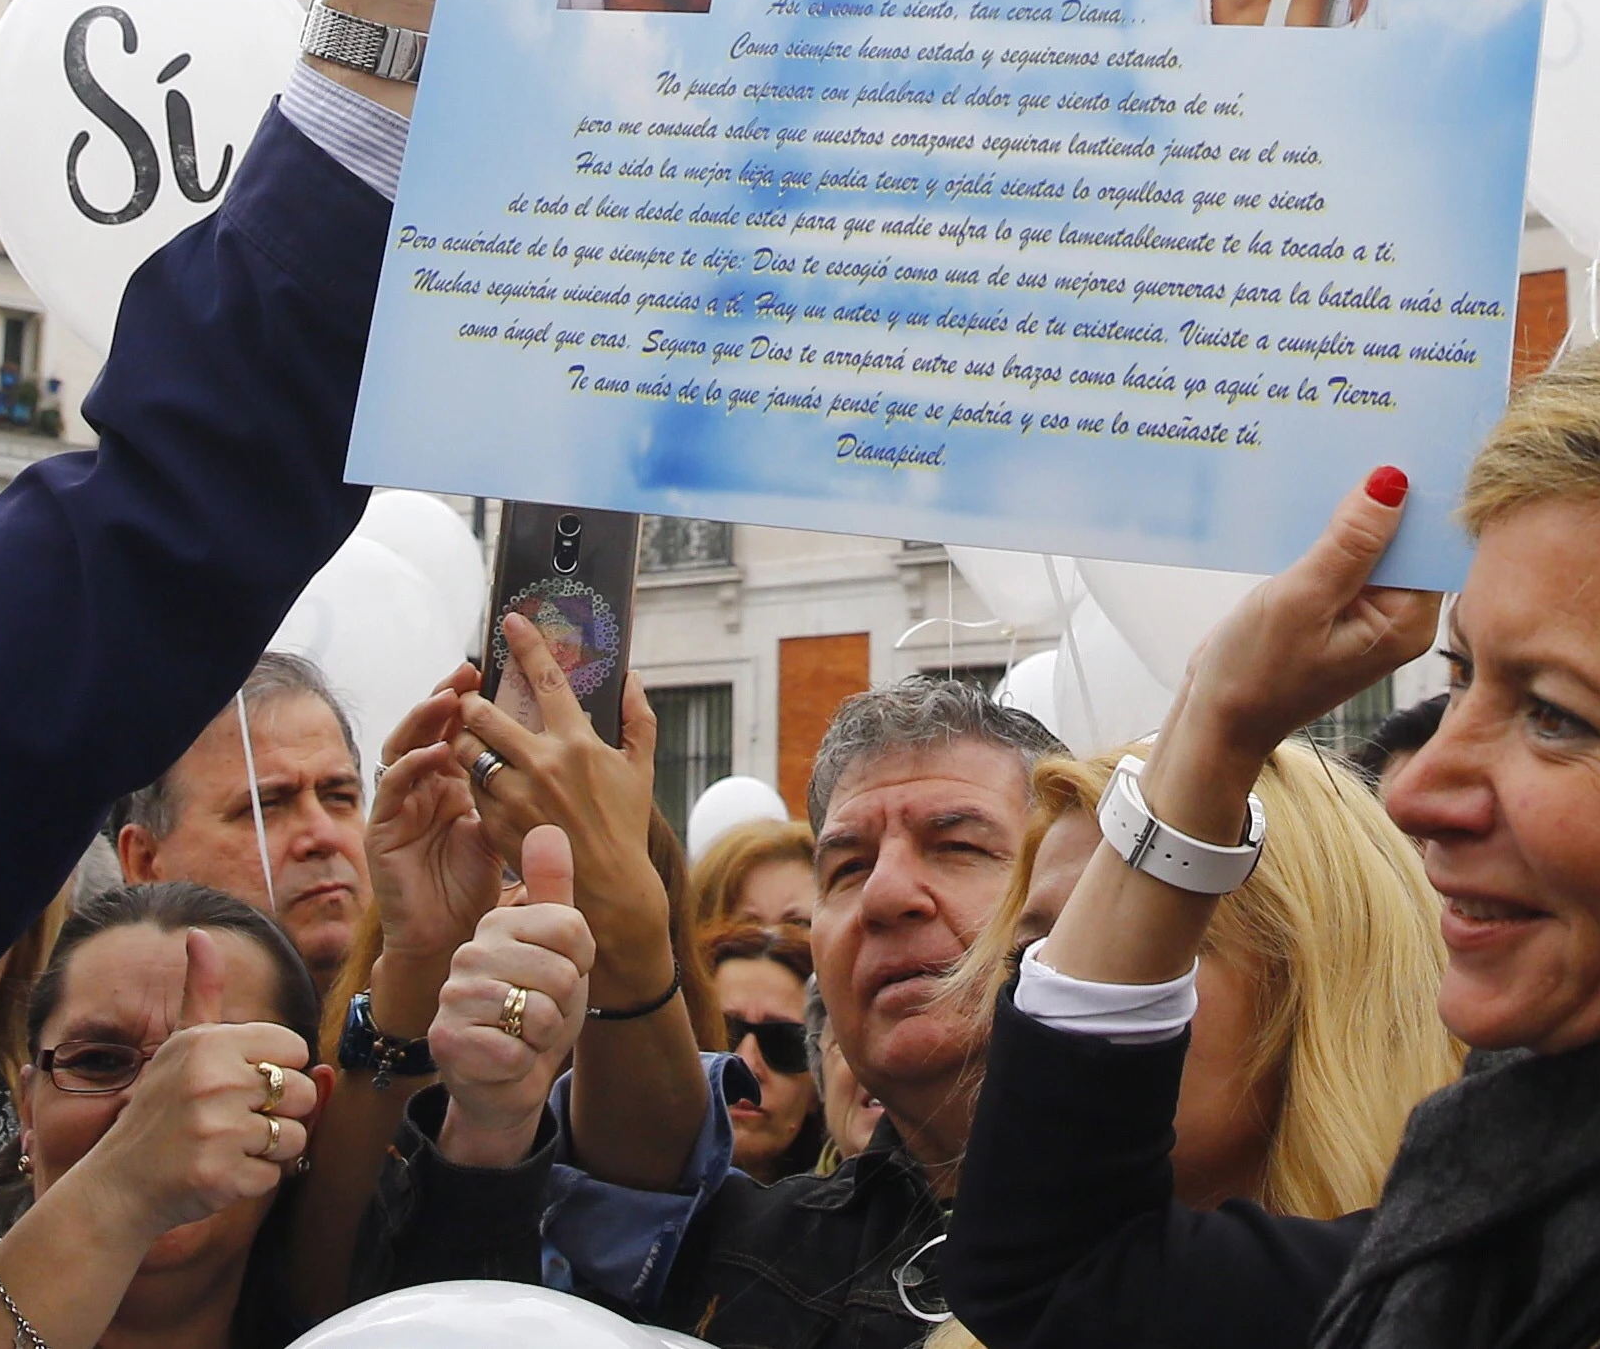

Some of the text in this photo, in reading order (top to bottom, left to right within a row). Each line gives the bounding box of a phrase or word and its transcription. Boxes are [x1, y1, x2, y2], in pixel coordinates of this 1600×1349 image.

[968, 0, 1002, 21] tan
[1005, 6, 1054, 23] cerca
[728, 30, 1184, 73] Como siempre hemos estado seguiremos estando.
[62, 4, 234, 226] Sí
[655, 69, 683, 97] No
[682, 75, 738, 102] puedo
[742, 81, 816, 104] expresar
[820, 86, 851, 102] con
[851, 78, 937, 110] palabras
[963, 84, 1012, 108] dolor
[1016, 92, 1052, 118] que
[1055, 91, 1112, 112] siento
[1115, 90, 1178, 115] dentro
[1182, 91, 1209, 117] de
[572, 115, 614, 139] pero
[616, 120, 644, 137] me
[646, 116, 719, 140] consuela
[723, 116, 772, 142] saber
[774, 126, 809, 151] que
[811, 125, 886, 147] nuestros
[889, 131, 976, 158] corazones
[980, 134, 1063, 161] seguiran
[1066, 131, 1157, 159] lantiendo
[1158, 139, 1223, 167] juntos
[1227, 145, 1252, 163] en
[574, 149, 614, 177] Has
[617, 155, 655, 179] sido
[682, 165, 734, 189] mejor
[777, 172, 815, 194] que
[873, 170, 921, 192] tener
[943, 171, 994, 202] ojalá
[998, 177, 1066, 200] sientas
[1095, 179, 1186, 212] orgullosa
[1191, 189, 1228, 216] que
[1232, 192, 1263, 210] me
[1267, 190, 1326, 213] siento
[507, 191, 531, 215] de
[532, 193, 570, 217] todo
[594, 193, 631, 220] bien
[633, 198, 685, 224] desde
[687, 201, 742, 227] donde
[744, 208, 788, 229] estés
[789, 211, 838, 236] para
[841, 216, 877, 242] que
[879, 213, 934, 238] nadie
[937, 215, 989, 249] sufra
[1017, 226, 1054, 252] que
[1057, 220, 1217, 254] lamentablemente
[1246, 228, 1274, 257] ha
[1279, 235, 1346, 261] tocado
[396, 223, 438, 251] Pero
[441, 232, 524, 257] acuérdate
[525, 235, 549, 258] de
[572, 244, 605, 269] que
[607, 245, 677, 271] siempre
[751, 245, 797, 274] Dios
[824, 259, 890, 287] escogió
[892, 264, 940, 283] como
[943, 268, 981, 286] una
[985, 263, 1012, 288] de
[1014, 271, 1049, 290] sus
[1053, 275, 1127, 300] mejores
[1131, 279, 1227, 305] guerreras
[1228, 281, 1283, 309] para
[1316, 279, 1393, 312] batalla
[1398, 286, 1443, 315] más
[1448, 290, 1507, 320] dura.
[412, 266, 482, 296] Muchas
[485, 280, 559, 306] seguirán
[561, 283, 632, 307] viviendo
[633, 291, 702, 316] gracias
[754, 289, 799, 325] Hay
[802, 304, 828, 320] un
[831, 302, 882, 324] antes
[904, 311, 931, 328] un
[934, 305, 1010, 338] después
[1014, 310, 1040, 336] de
[1044, 314, 1068, 337] tu
[1072, 318, 1171, 346] existencia.
[1178, 317, 1251, 350] Viniste
[1276, 330, 1357, 362] cumplir
[1361, 341, 1402, 361] una
[1407, 337, 1478, 366] misión
[457, 320, 1398, 410] como ángel que eras. Seguro que Dios arropará entre sus brazos como hacía yo aquí en Tierra.
[566, 363, 1263, 449] Te amo más de que jamás pensé que se podría eso me enseñaste tú.
